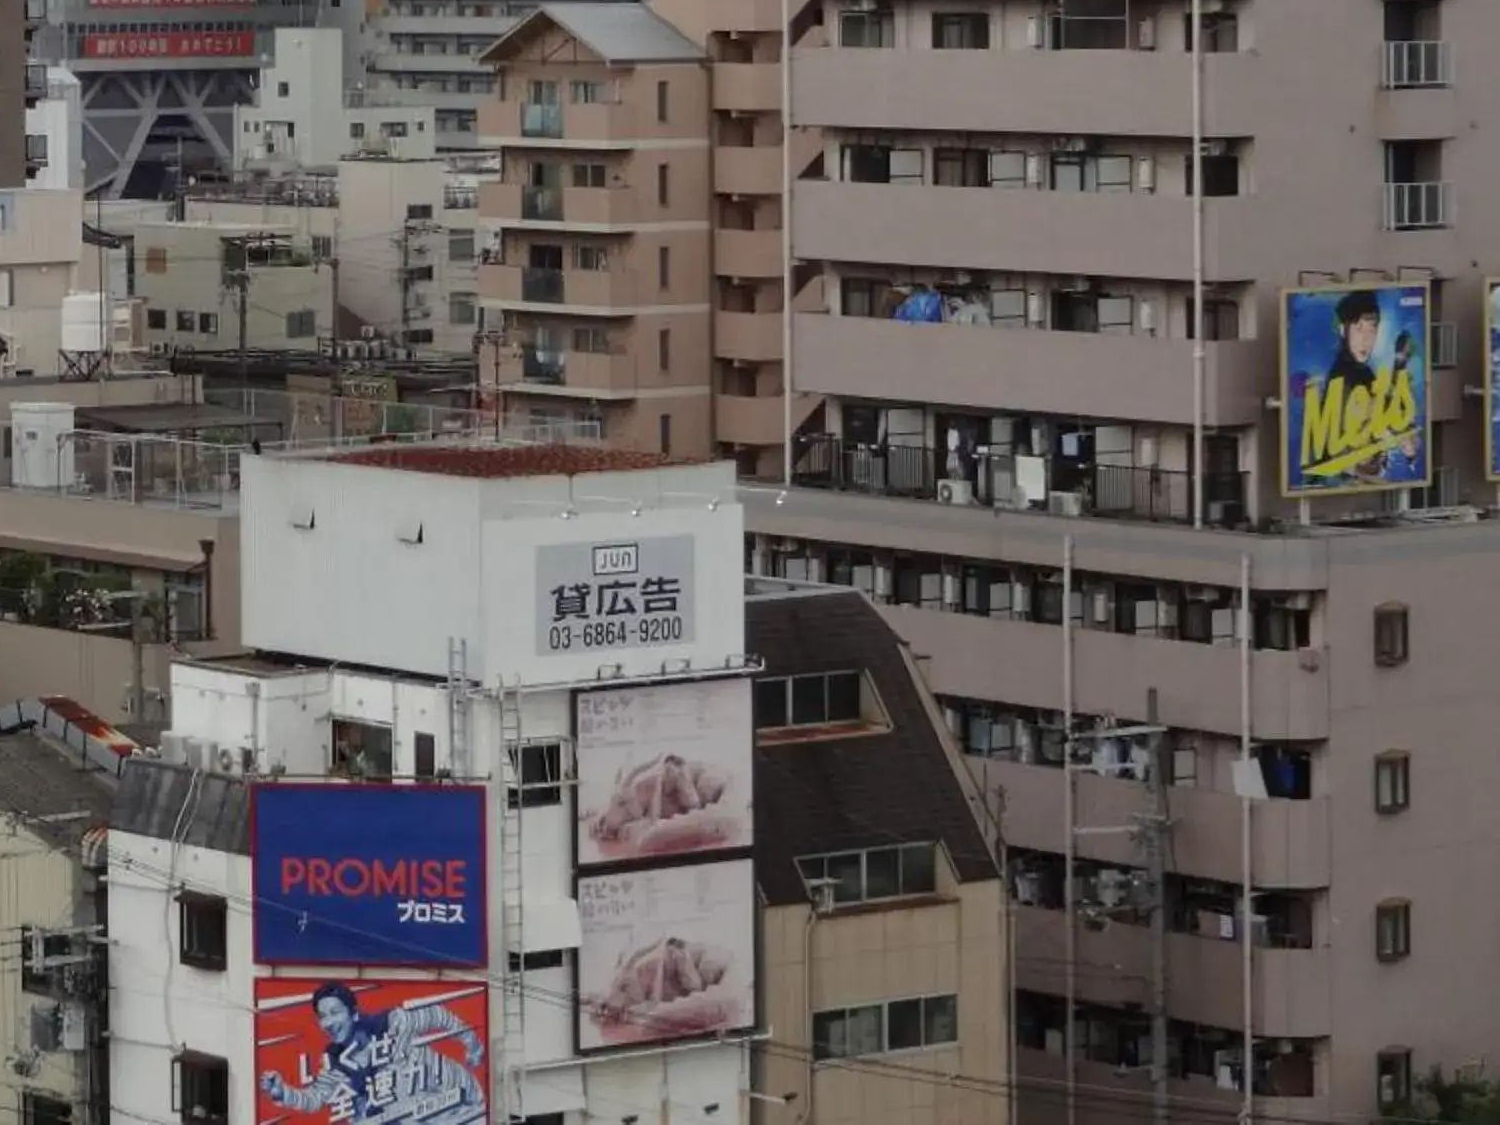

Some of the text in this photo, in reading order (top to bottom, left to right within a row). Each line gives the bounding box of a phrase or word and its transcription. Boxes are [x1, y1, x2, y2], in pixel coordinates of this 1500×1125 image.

[1301, 363, 1417, 465] Mets
[551, 576, 681, 622] 貸広告
[550, 616, 682, 650] 03-6864-9200
[281, 857, 466, 898] PROMISE
[397, 901, 465, 924] プロミス
